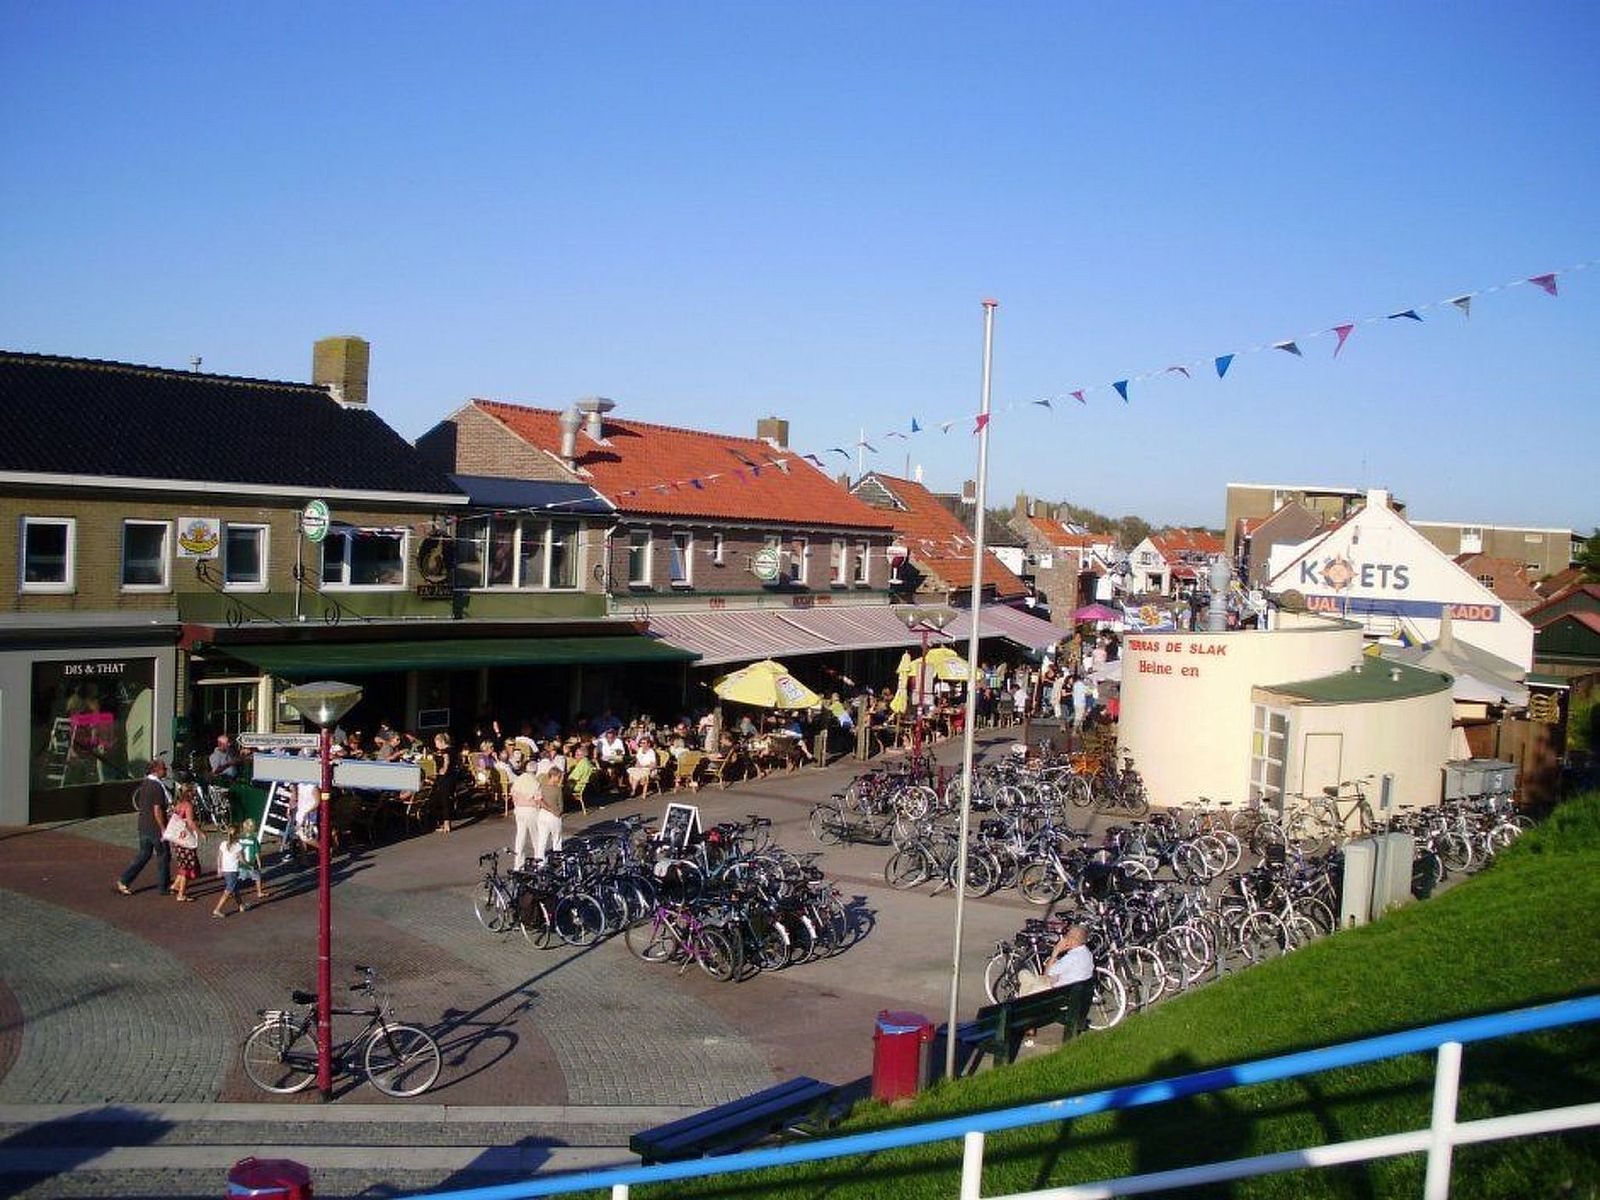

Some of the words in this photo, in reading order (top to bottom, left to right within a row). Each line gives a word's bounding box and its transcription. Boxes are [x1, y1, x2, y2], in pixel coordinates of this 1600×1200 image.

[1300, 556, 1410, 591] KOETS
[1448, 605, 1495, 620] KADO
[1165, 642, 1182, 653] DE
[1189, 644, 1227, 656] SLAK
[65, 664, 83, 675] DIS
[84, 664, 95, 675] &
[97, 663, 126, 674] THAT
[1139, 660, 1173, 675] Heine
[1181, 666, 1200, 677] en
